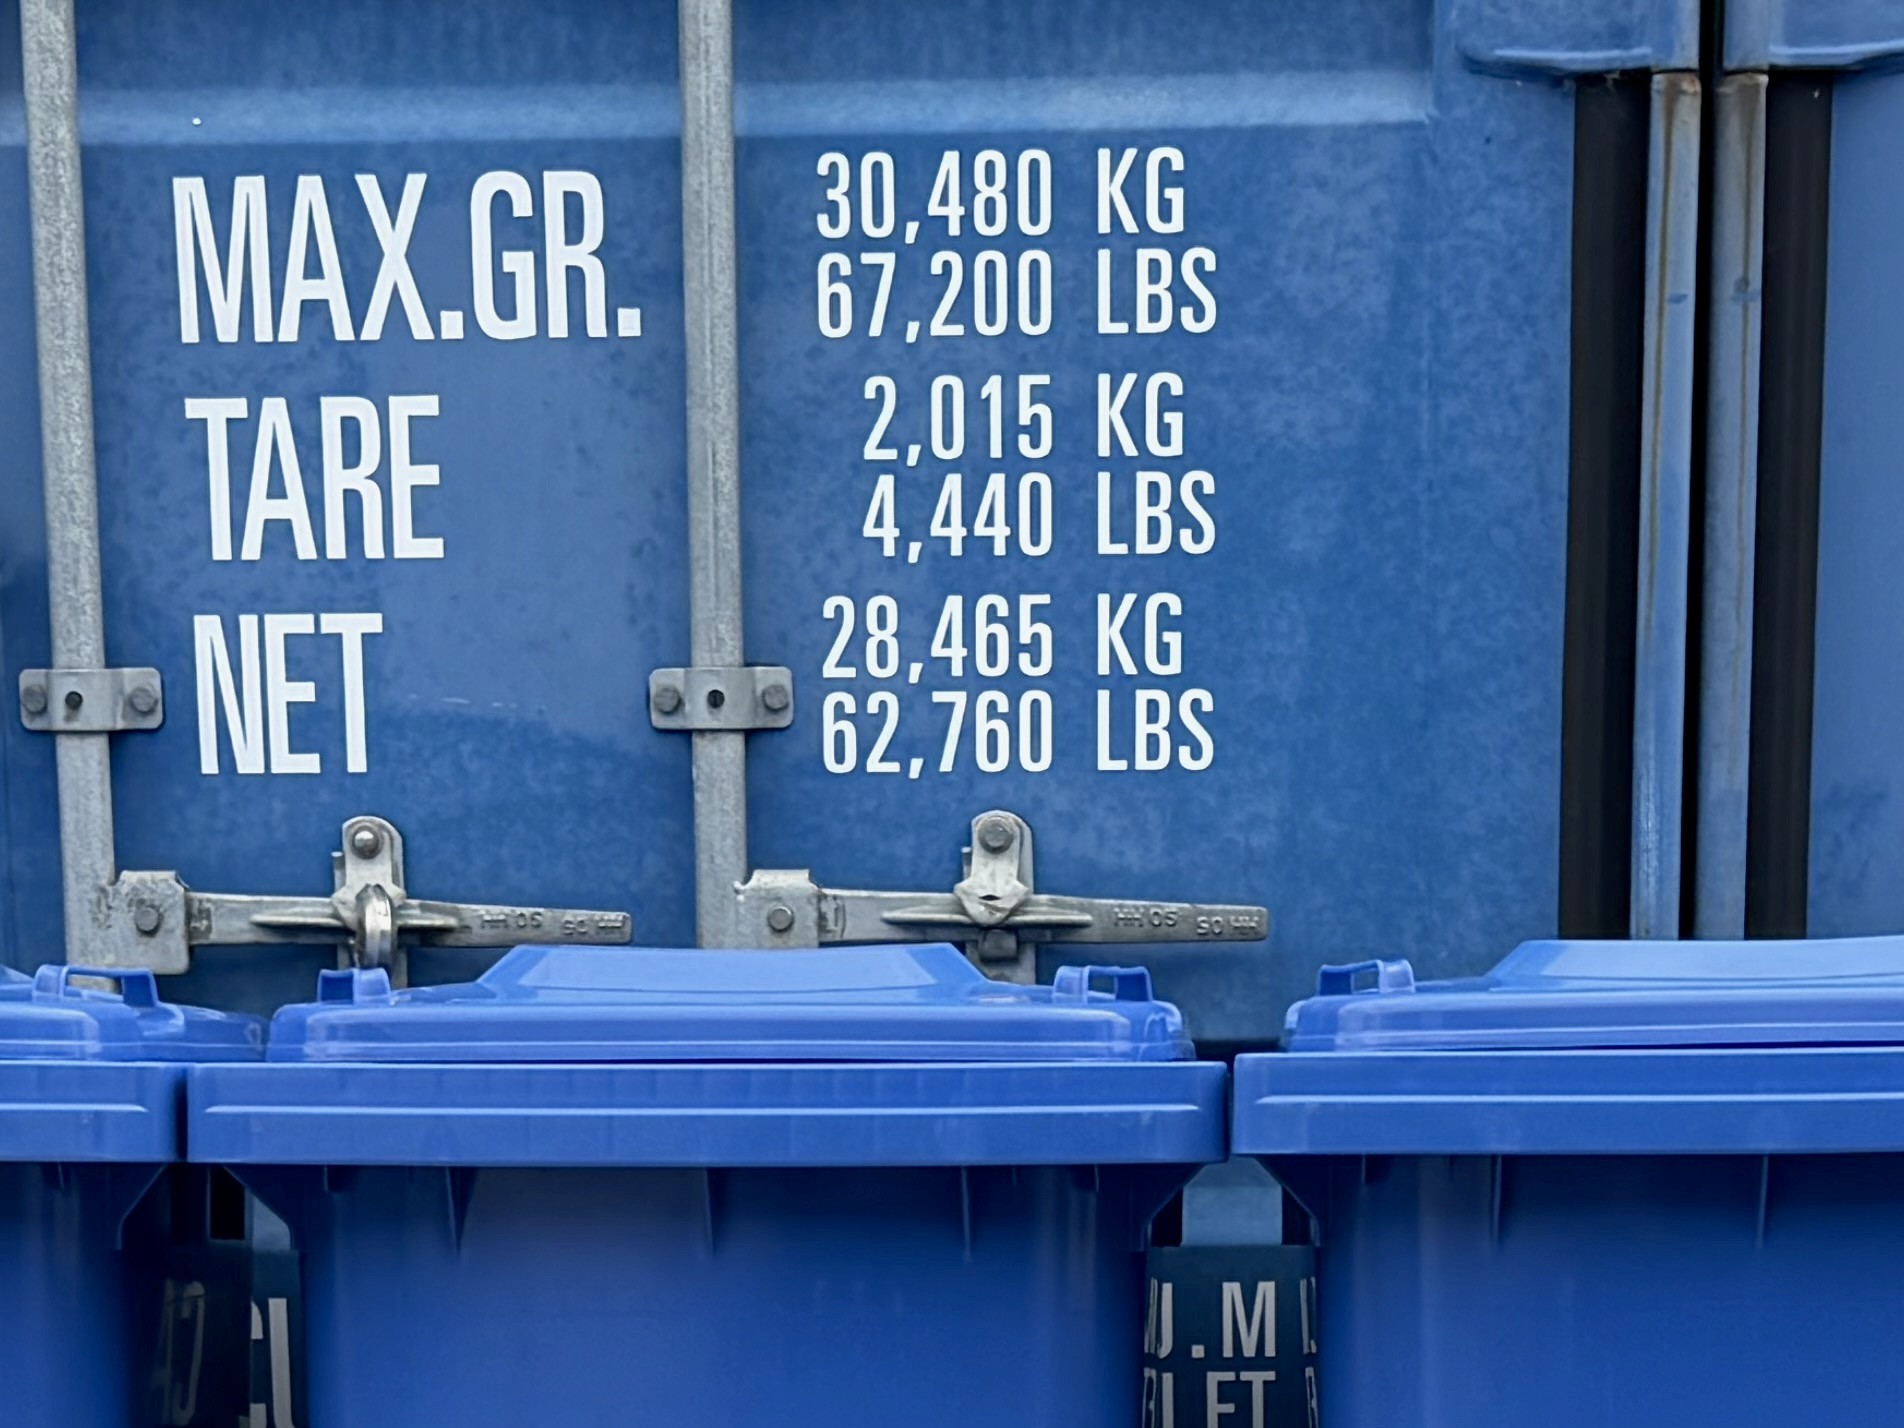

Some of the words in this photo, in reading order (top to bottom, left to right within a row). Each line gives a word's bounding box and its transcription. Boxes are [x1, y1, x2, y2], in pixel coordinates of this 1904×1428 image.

[815, 147, 1053, 245] 30,480
[1096, 145, 1186, 235] KG
[172, 169, 643, 345] MAX.GR.
[816, 247, 1053, 345] 67,200
[1096, 245, 1218, 335] LBS
[862, 373, 1054, 468] 2,015
[1096, 370, 1185, 459] KG
[183, 393, 446, 562] TARE
[861, 471, 1054, 565] 4,440
[1096, 468, 1217, 556] LBS
[821, 592, 1054, 685] 28,465
[1096, 591, 1183, 677] KG
[192, 611, 385, 776] NET
[821, 688, 1054, 781] 62,760
[1096, 687, 1215, 772] LBS
